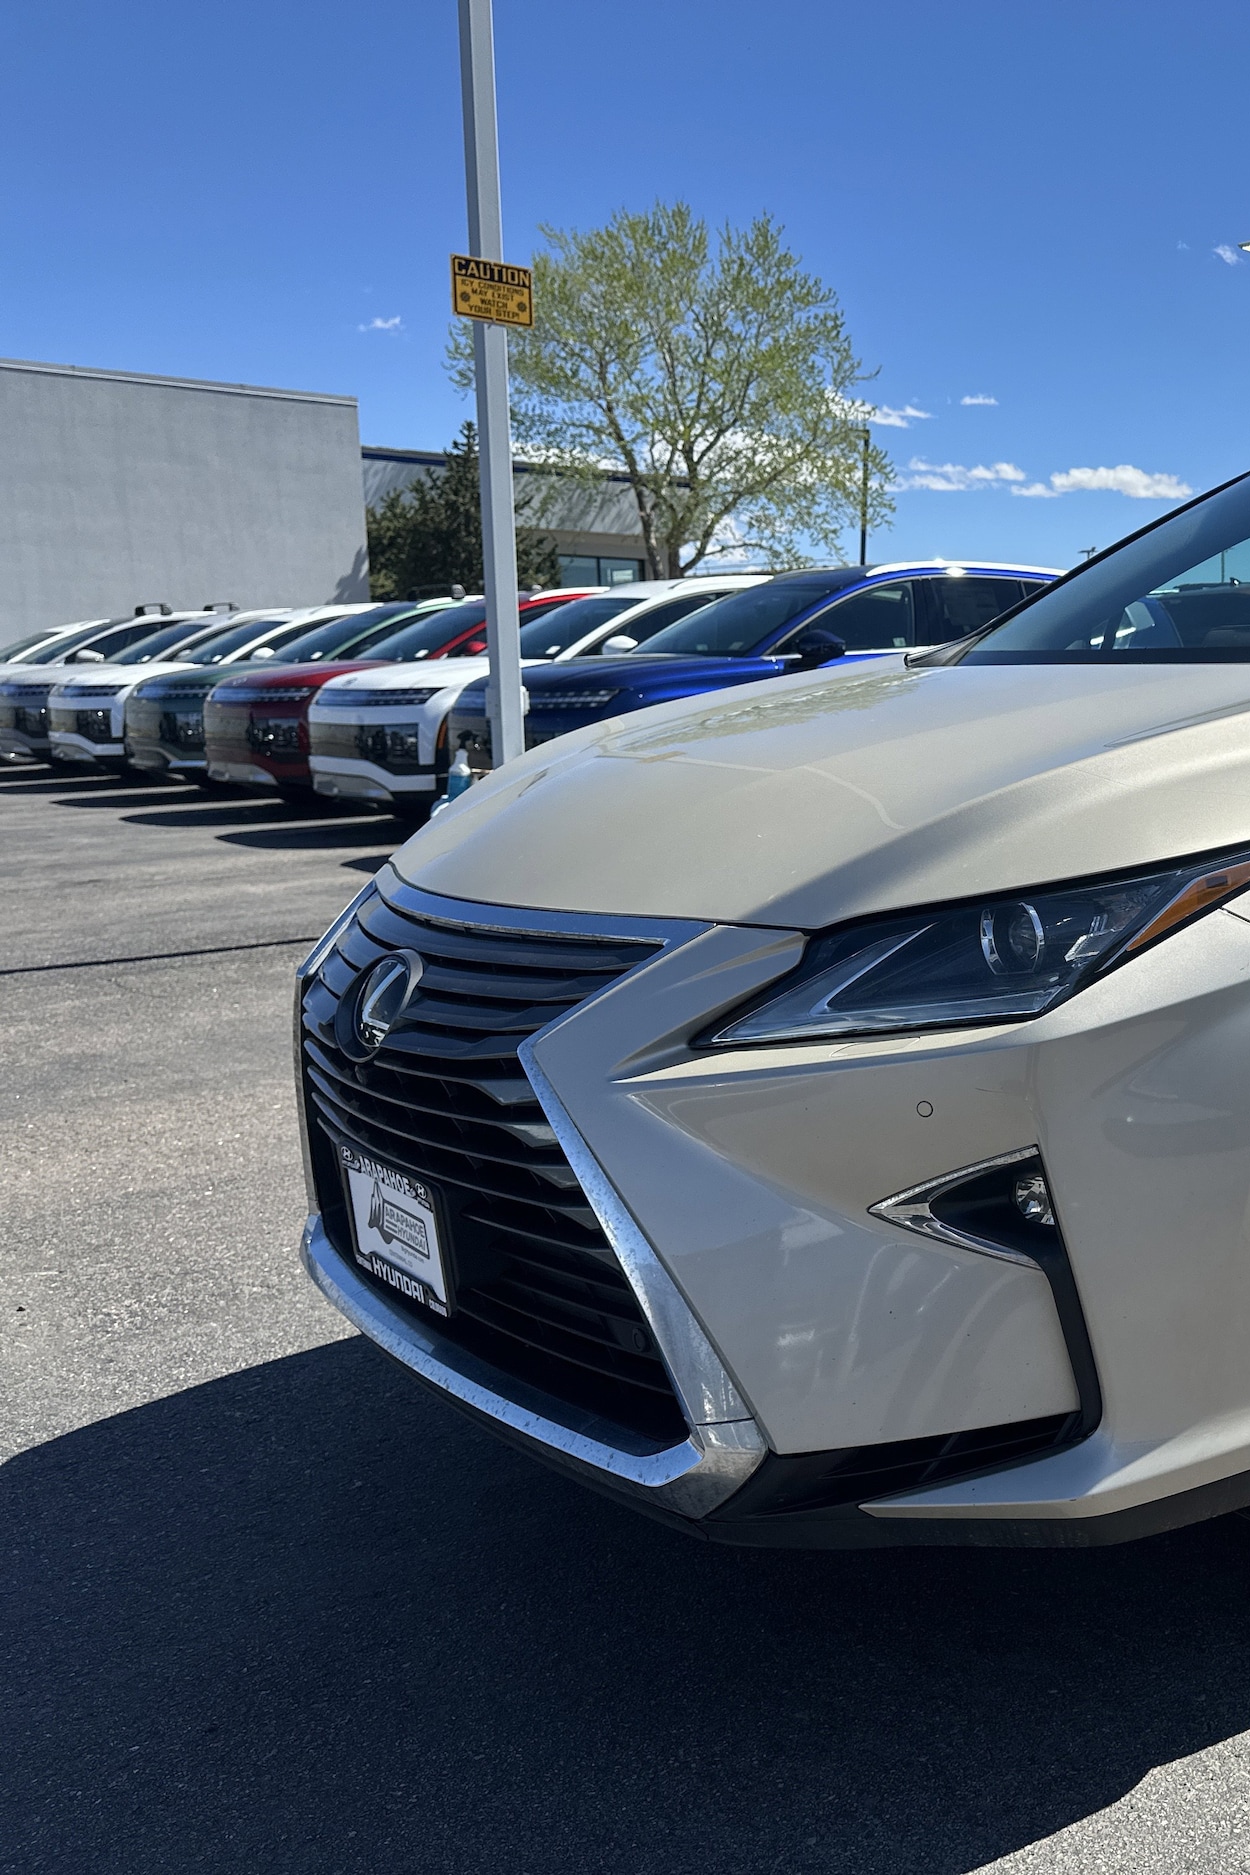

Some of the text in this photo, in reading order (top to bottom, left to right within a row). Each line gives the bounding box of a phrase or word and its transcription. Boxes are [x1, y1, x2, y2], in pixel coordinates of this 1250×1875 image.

[454, 258, 530, 287] CAUTION
[471, 287, 488, 297] MAY
[480, 297, 508, 309] WATCH
[468, 303, 492, 315] YOUR
[359, 1154, 412, 1196] ARAPAHOE
[385, 1206, 426, 1239] ARAPAHOE
[397, 1225, 426, 1251] HYUNDAI
[371, 1256, 425, 1304] HYUNDAI
